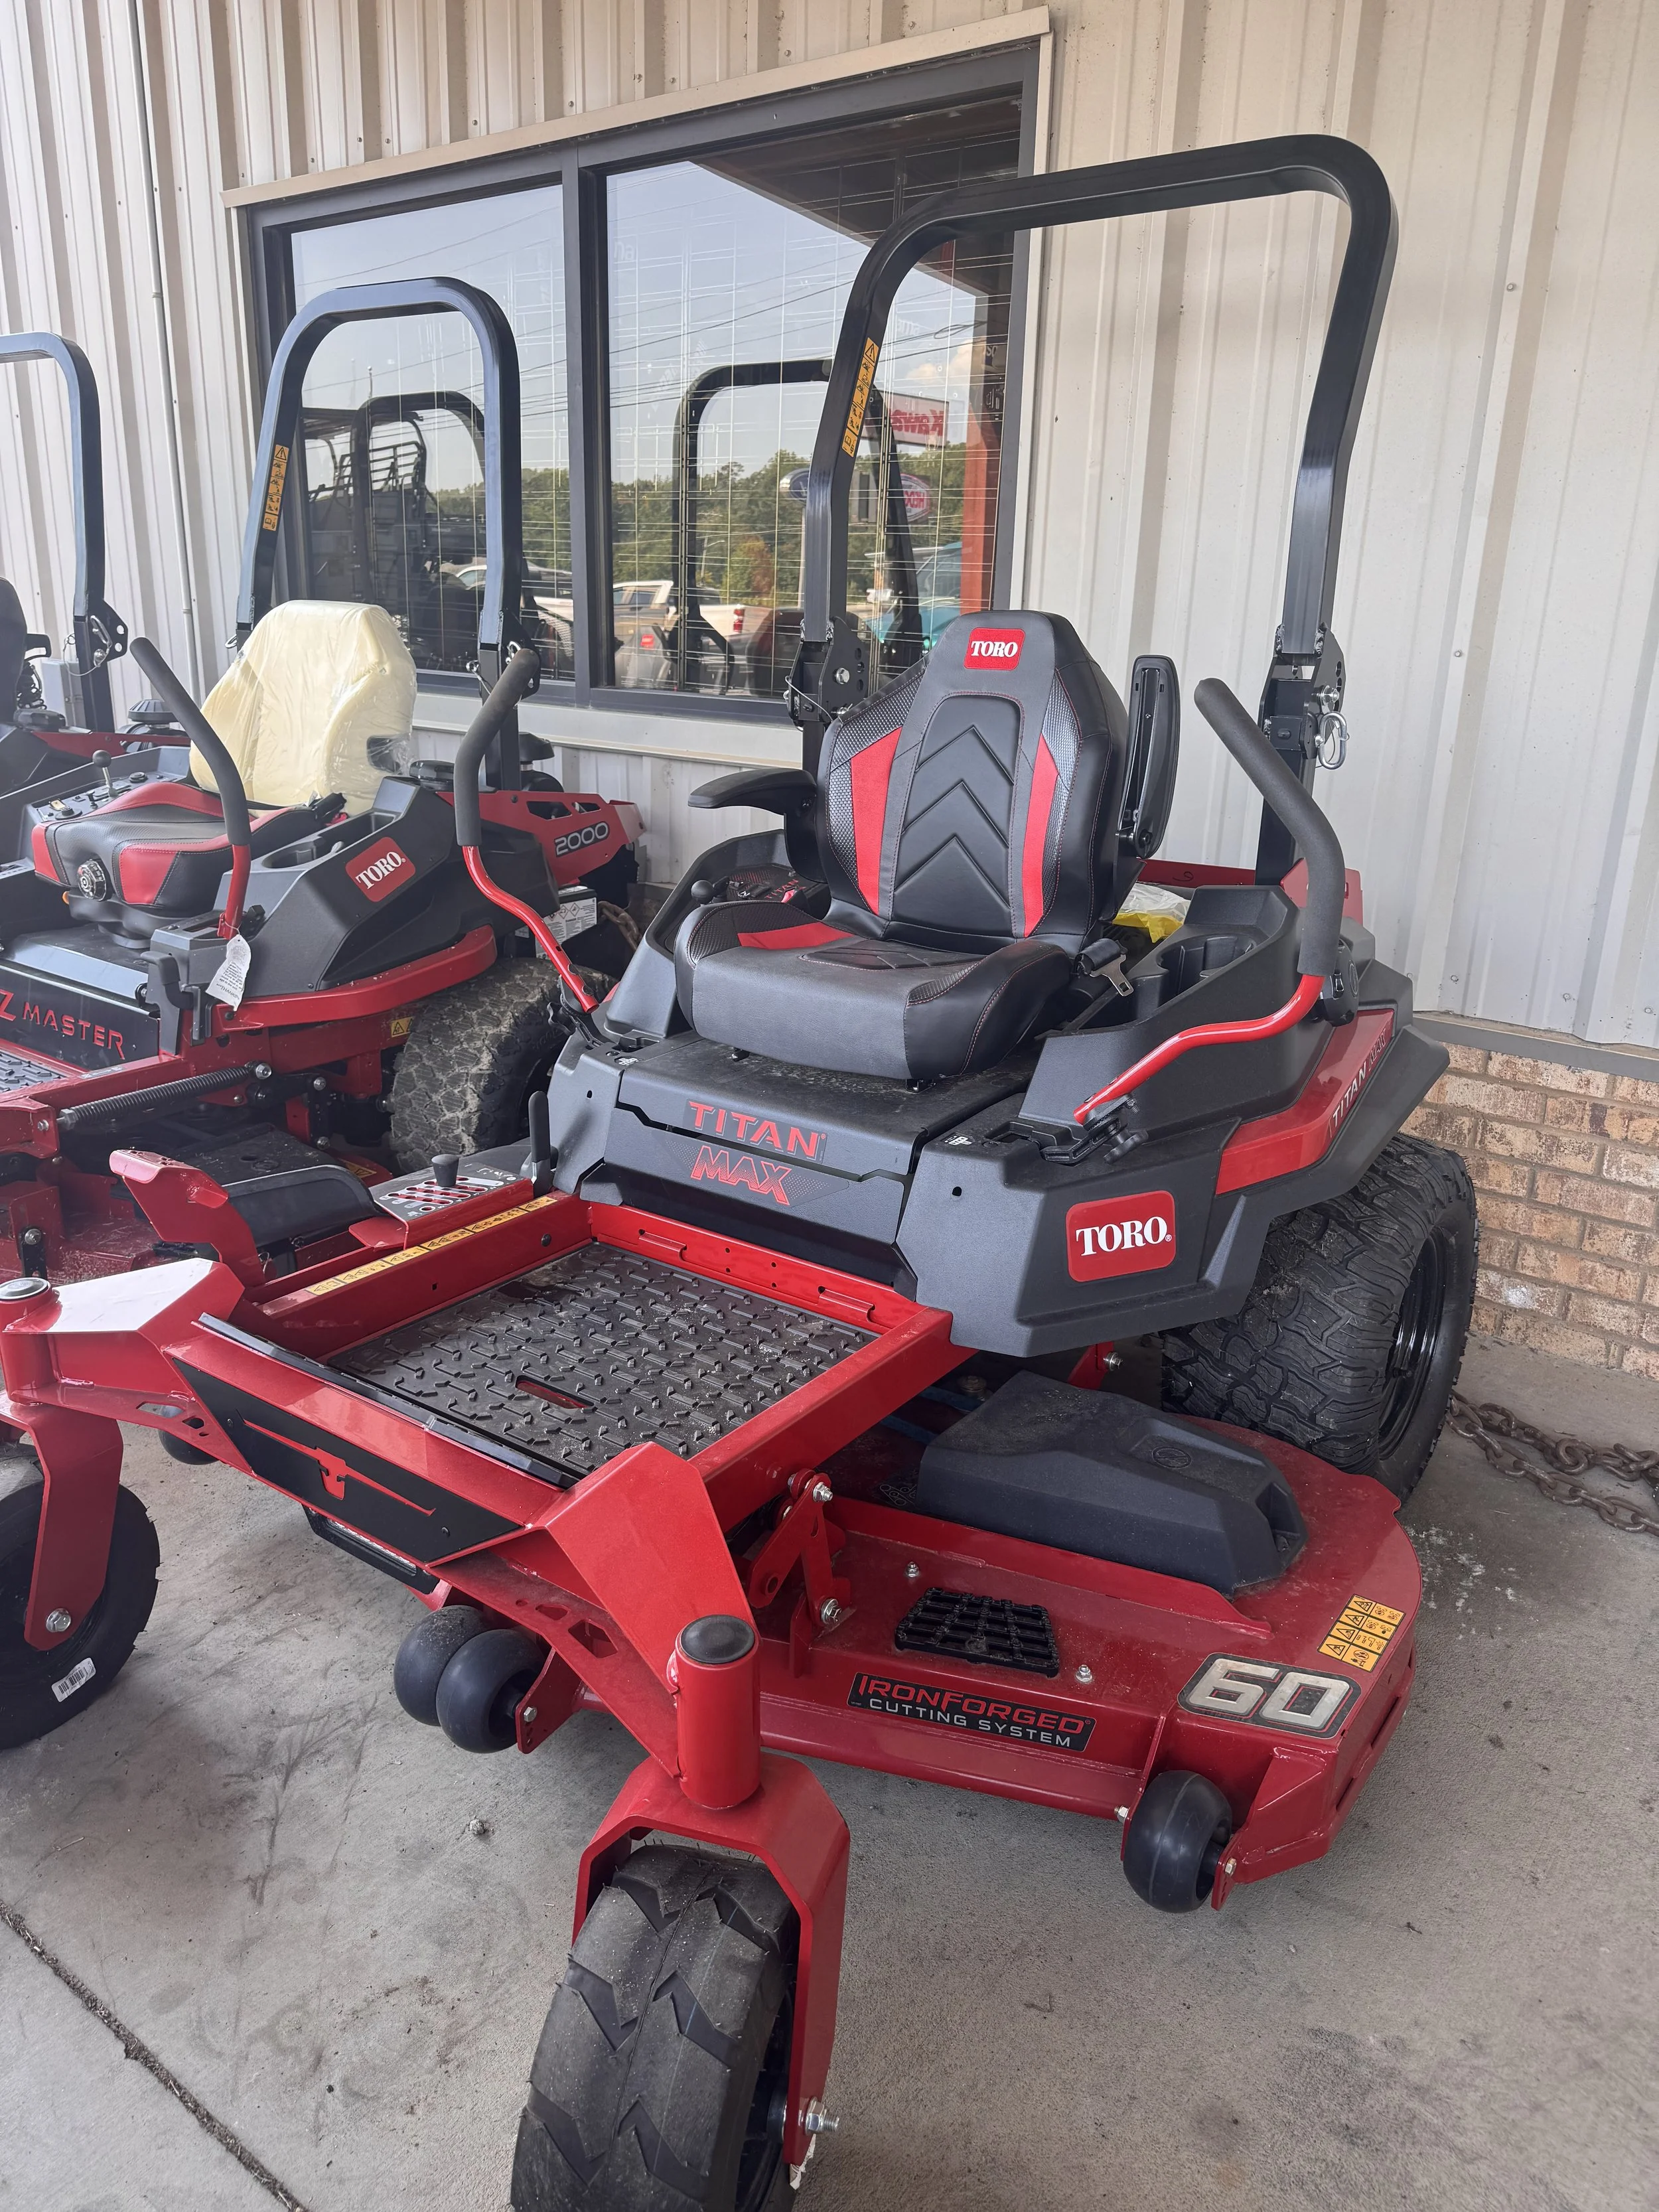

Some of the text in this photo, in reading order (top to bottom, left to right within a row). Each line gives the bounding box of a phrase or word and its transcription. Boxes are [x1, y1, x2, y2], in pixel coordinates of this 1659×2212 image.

[971, 640, 1018, 658] TORO
[555, 822, 609, 855] 2000
[355, 851, 402, 889] TORO
[0, 988, 125, 1060] Z MASTER
[1333, 1061, 1366, 1128] TITAN
[689, 1100, 820, 1159] TITAN
[690, 1145, 792, 1206] MAX
[1076, 1216, 1168, 1256] TORO
[859, 1675, 1085, 1735] IRONFORGED
[869, 1698, 1071, 1747] CUTTING SYSTEM
[1189, 1658, 1351, 1728] 60
